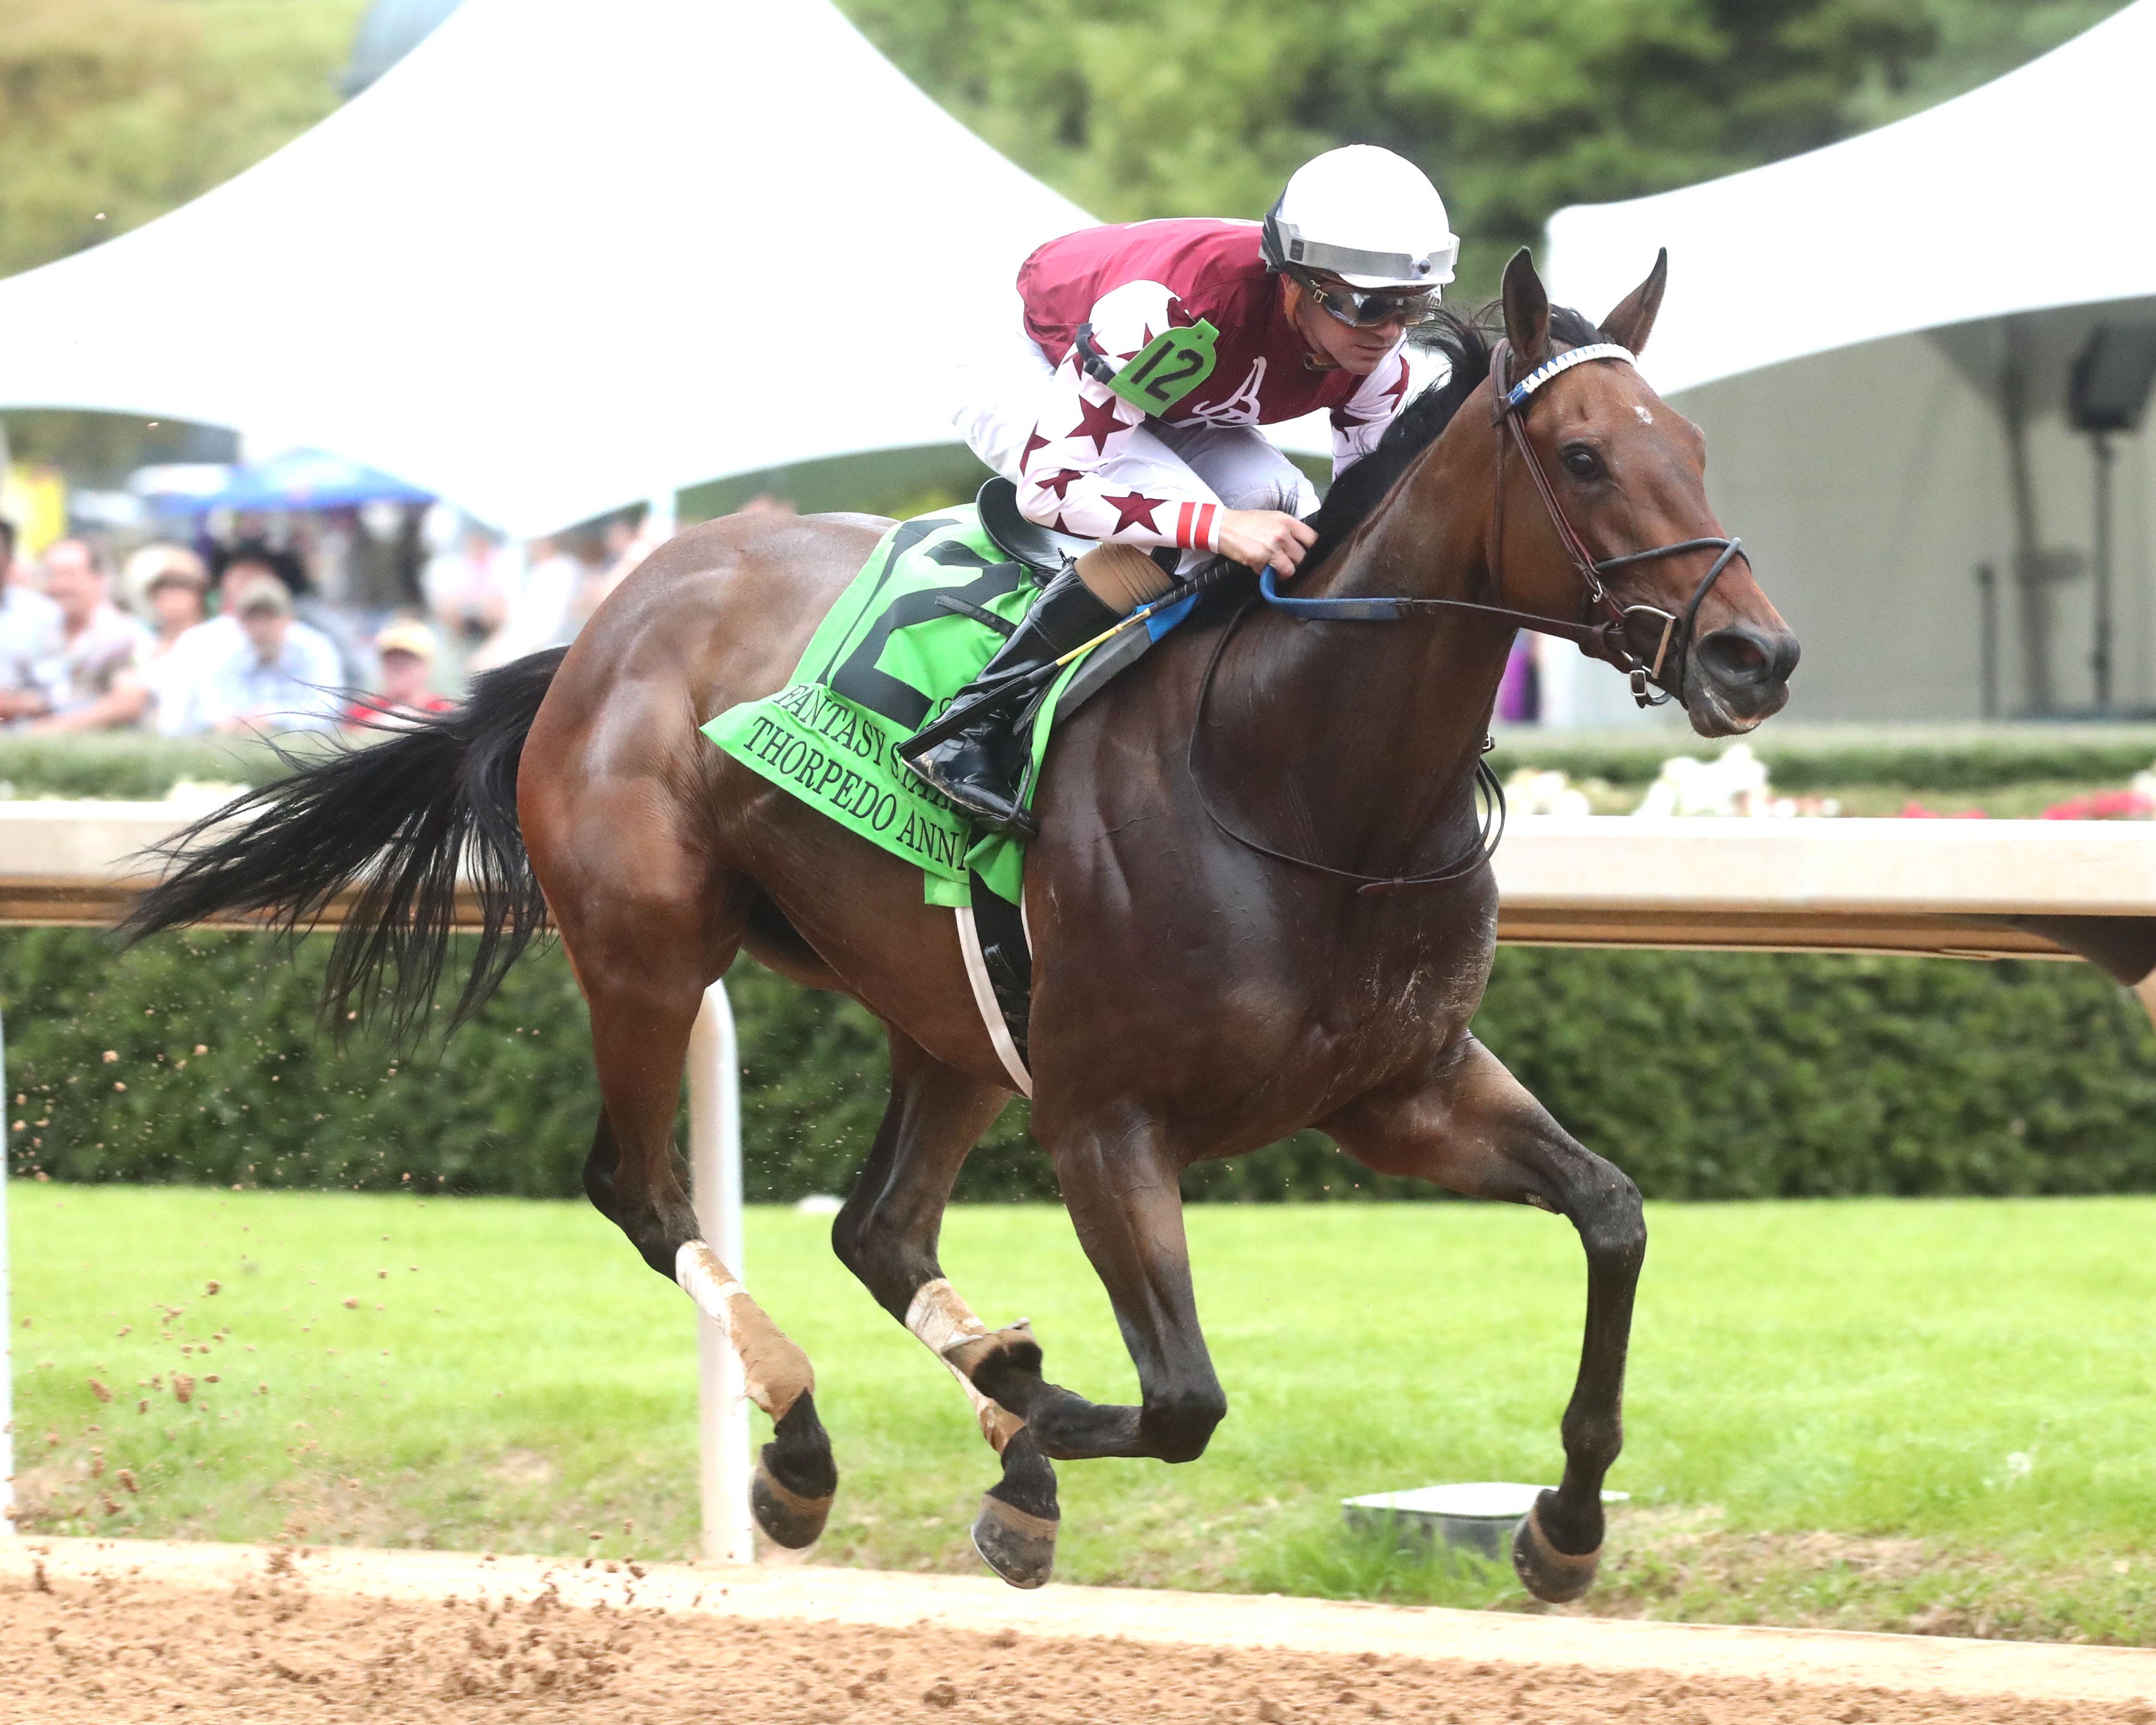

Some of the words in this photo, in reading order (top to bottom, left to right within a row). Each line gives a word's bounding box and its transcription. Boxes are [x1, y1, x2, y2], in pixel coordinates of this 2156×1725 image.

[1130, 340, 1204, 401] 12
[773, 685, 886, 766] FANTASY
[743, 716, 897, 831] THORPEDO
